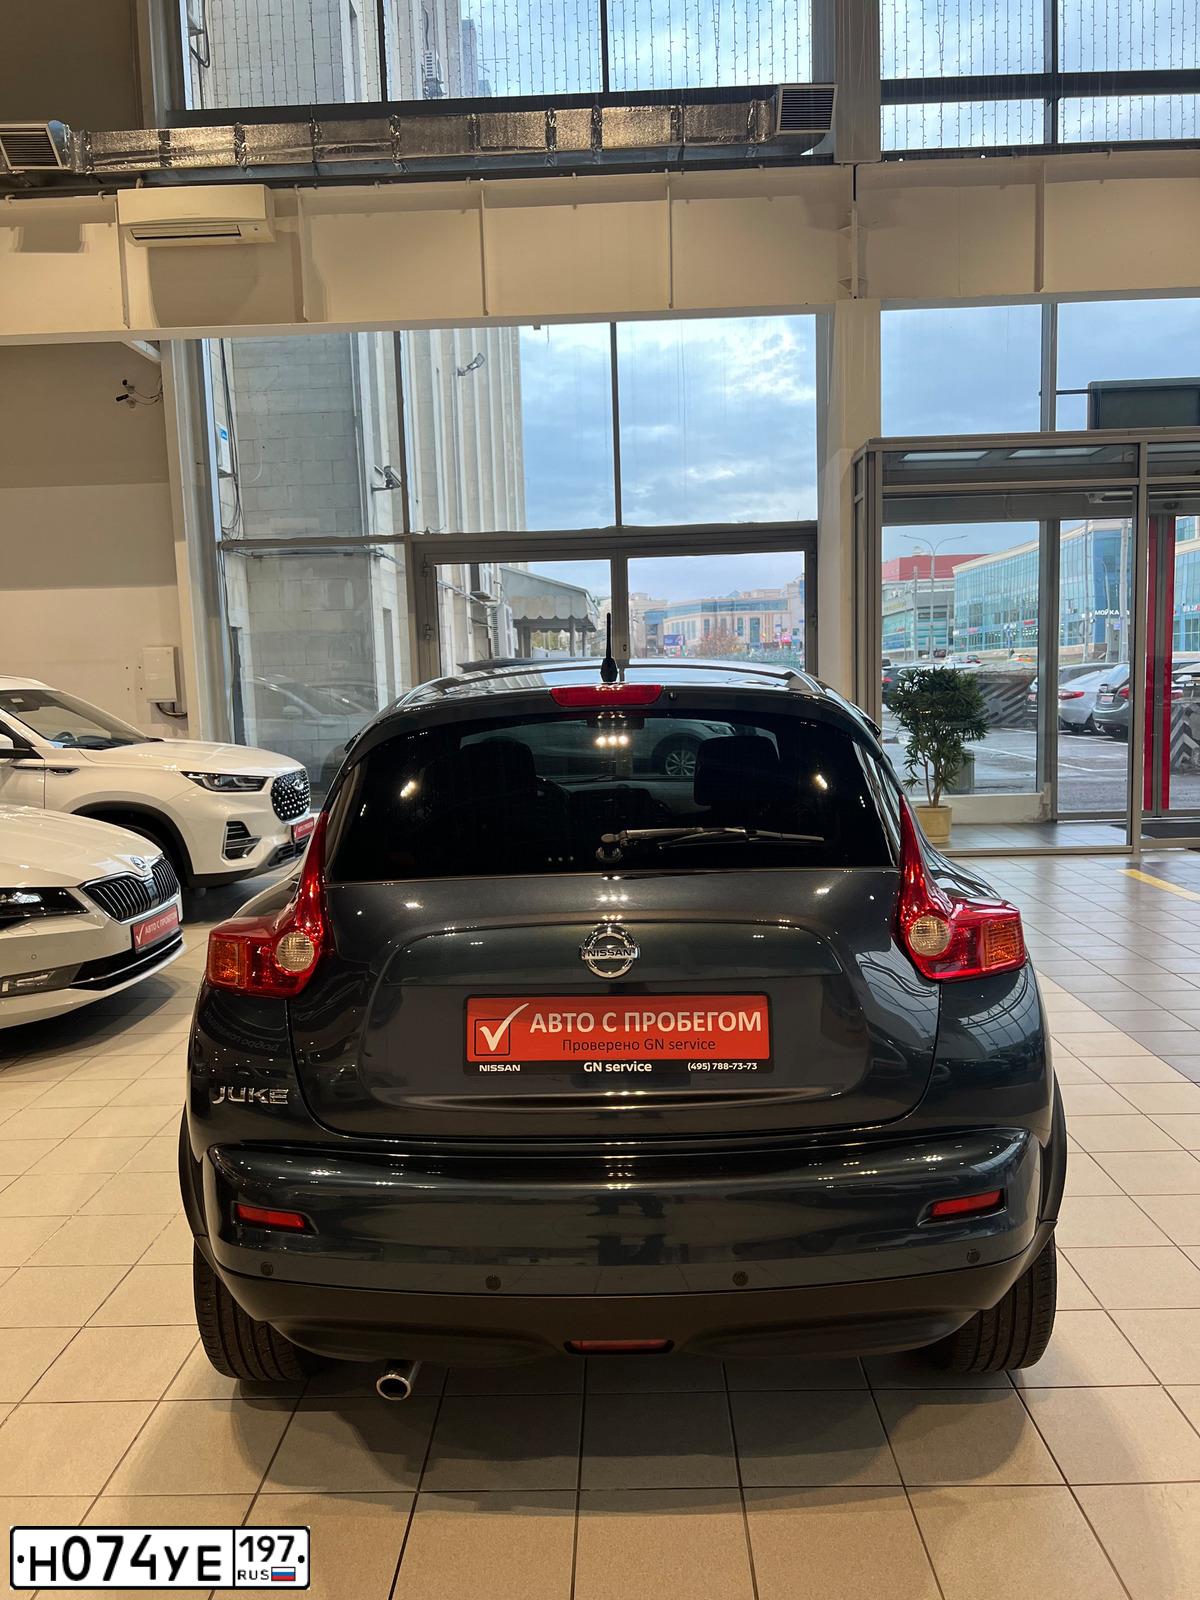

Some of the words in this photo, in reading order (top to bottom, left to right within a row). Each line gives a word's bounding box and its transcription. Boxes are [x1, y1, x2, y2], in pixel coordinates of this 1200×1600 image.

[587, 949, 632, 957] NISSAN
[529, 1012, 595, 1033] АВТО
[602, 1012, 617, 1032] С
[624, 1011, 761, 1032] ПРОБЕГОМ
[562, 1039, 640, 1053] Проверено
[644, 1038, 664, 1050] GN
[669, 1038, 716, 1050] service
[479, 1064, 521, 1072] NISSAN
[583, 1061, 603, 1072] GN
[605, 1060, 653, 1072] service
[687, 1062, 711, 1072] (495)
[712, 1062, 758, 1071] 788-73-73
[211, 1086, 289, 1104] JUKE
